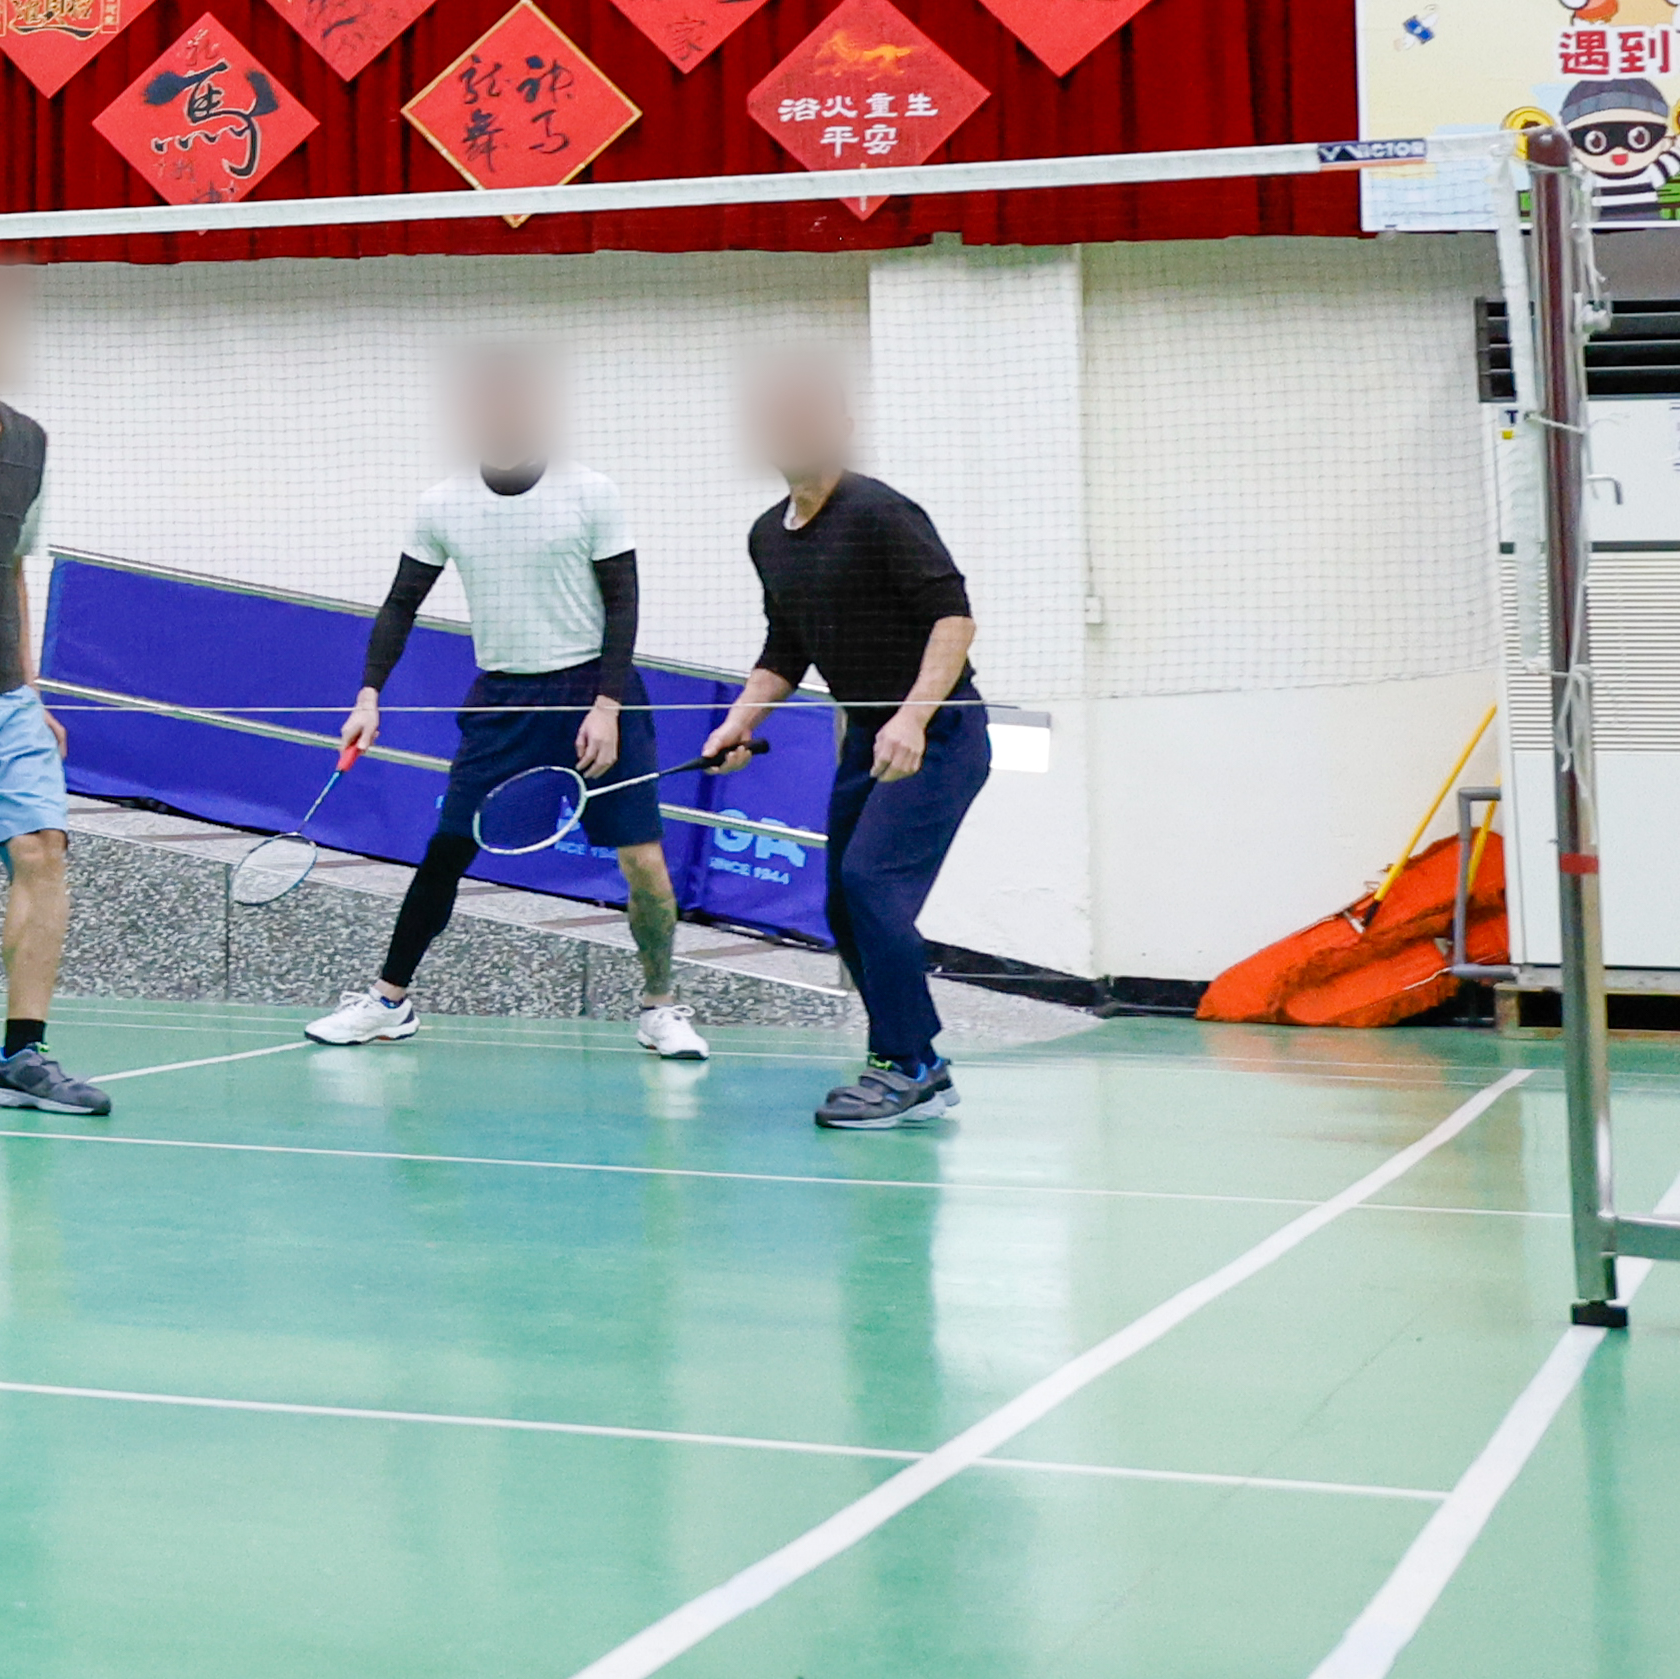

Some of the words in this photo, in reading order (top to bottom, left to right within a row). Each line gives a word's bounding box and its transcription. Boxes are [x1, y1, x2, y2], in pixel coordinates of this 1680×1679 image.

[1559, 29, 1670, 76] 遇到
[777, 92, 939, 122] 浴火重生
[820, 123, 899, 158] 平安
[1344, 141, 1425, 160] VICTOR
